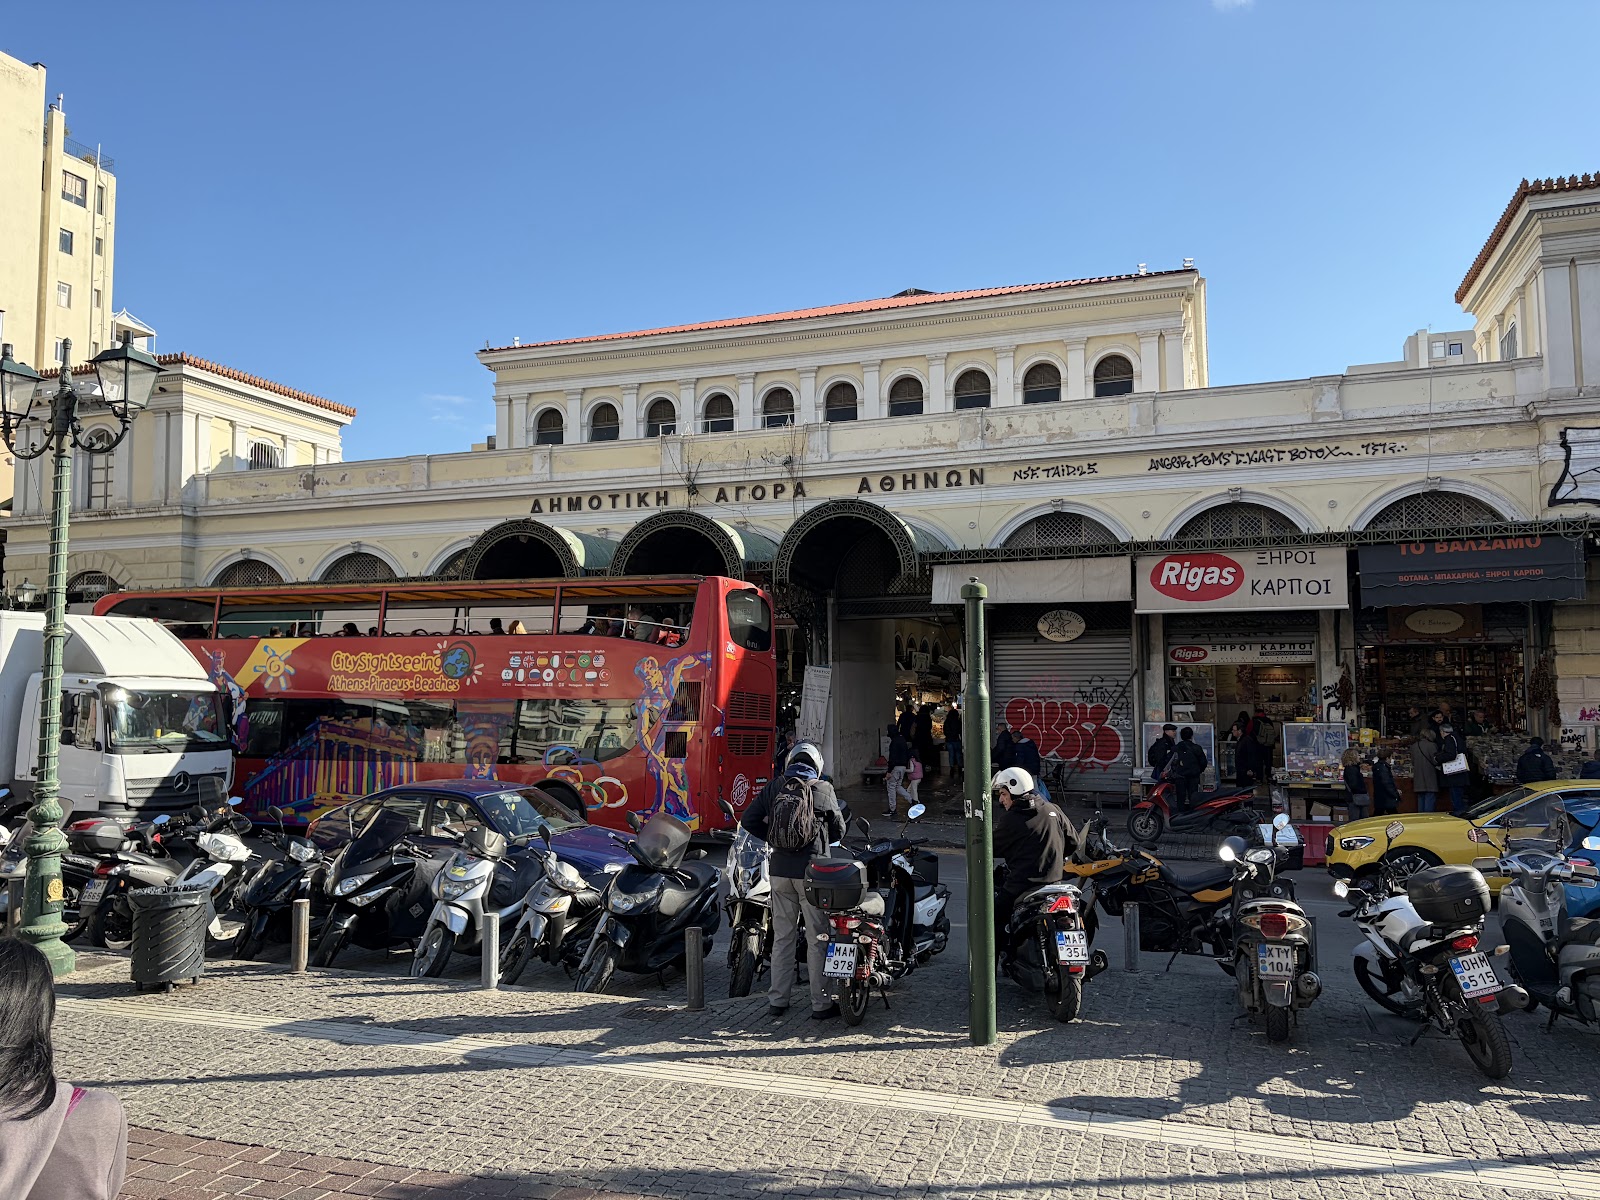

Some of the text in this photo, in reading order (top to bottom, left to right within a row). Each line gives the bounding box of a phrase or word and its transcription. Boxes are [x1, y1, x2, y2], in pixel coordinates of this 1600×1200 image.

[530, 467, 985, 514] ΔΗΜΟΤΙΚΗ ΑΓΟΡΑ ΑΘΗΝΩΝ
[1256, 551, 1317, 565] ΞΗΡΟΙ
[1160, 562, 1237, 592] Rigas
[1398, 574, 1430, 582] ΒΟΤΑΝΑ
[1434, 572, 1481, 581] ΜΠΑΧΑΡΙΚΑ
[1485, 570, 1511, 578] ΞΗΡΟΙ
[1513, 568, 1545, 577] ΚΑΡΠΟΙ
[1251, 578, 1332, 596] ΚΑΡΠΟΙ
[1211, 642, 1313, 652] ΞΗΡΟΙ ΚΑΡΠΟΙ
[1174, 649, 1206, 660] Rigas
[331, 650, 443, 675] CitySightseeing
[1081, 687, 1117, 704] BOTOX
[1131, 867, 1160, 885] GS
[1065, 933, 1085, 944] MAP
[834, 946, 856, 957] MAM
[1066, 947, 1087, 958] 354
[1266, 946, 1290, 959] XTY
[832, 960, 854, 971] 978
[1268, 961, 1291, 973] 104
[1461, 955, 1489, 971] OHM
[1467, 971, 1495, 987] 515
